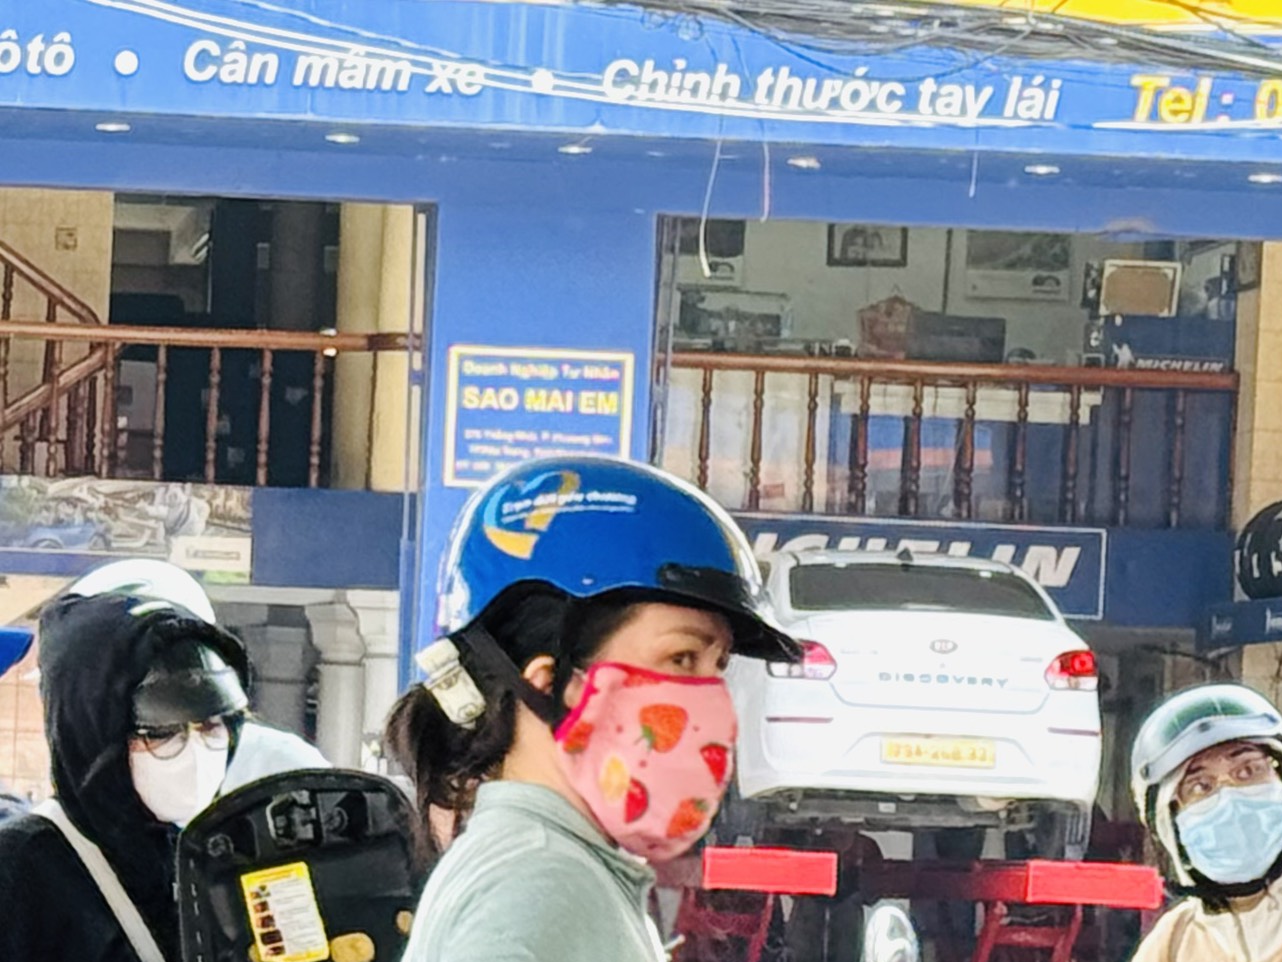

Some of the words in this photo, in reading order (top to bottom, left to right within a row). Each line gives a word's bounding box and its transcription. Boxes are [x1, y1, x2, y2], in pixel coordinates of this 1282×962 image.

[182, 39, 280, 85] Cân
[424, 60, 486, 97] xe
[602, 58, 742, 106] Chỉnh
[754, 65, 907, 113] thước
[918, 76, 994, 125] tay
[1003, 75, 1063, 120] lái
[462, 386, 519, 411] SAO
[524, 388, 574, 413] MAI
[578, 391, 619, 415] EM
[878, 672, 1009, 688] DISCOVERY
